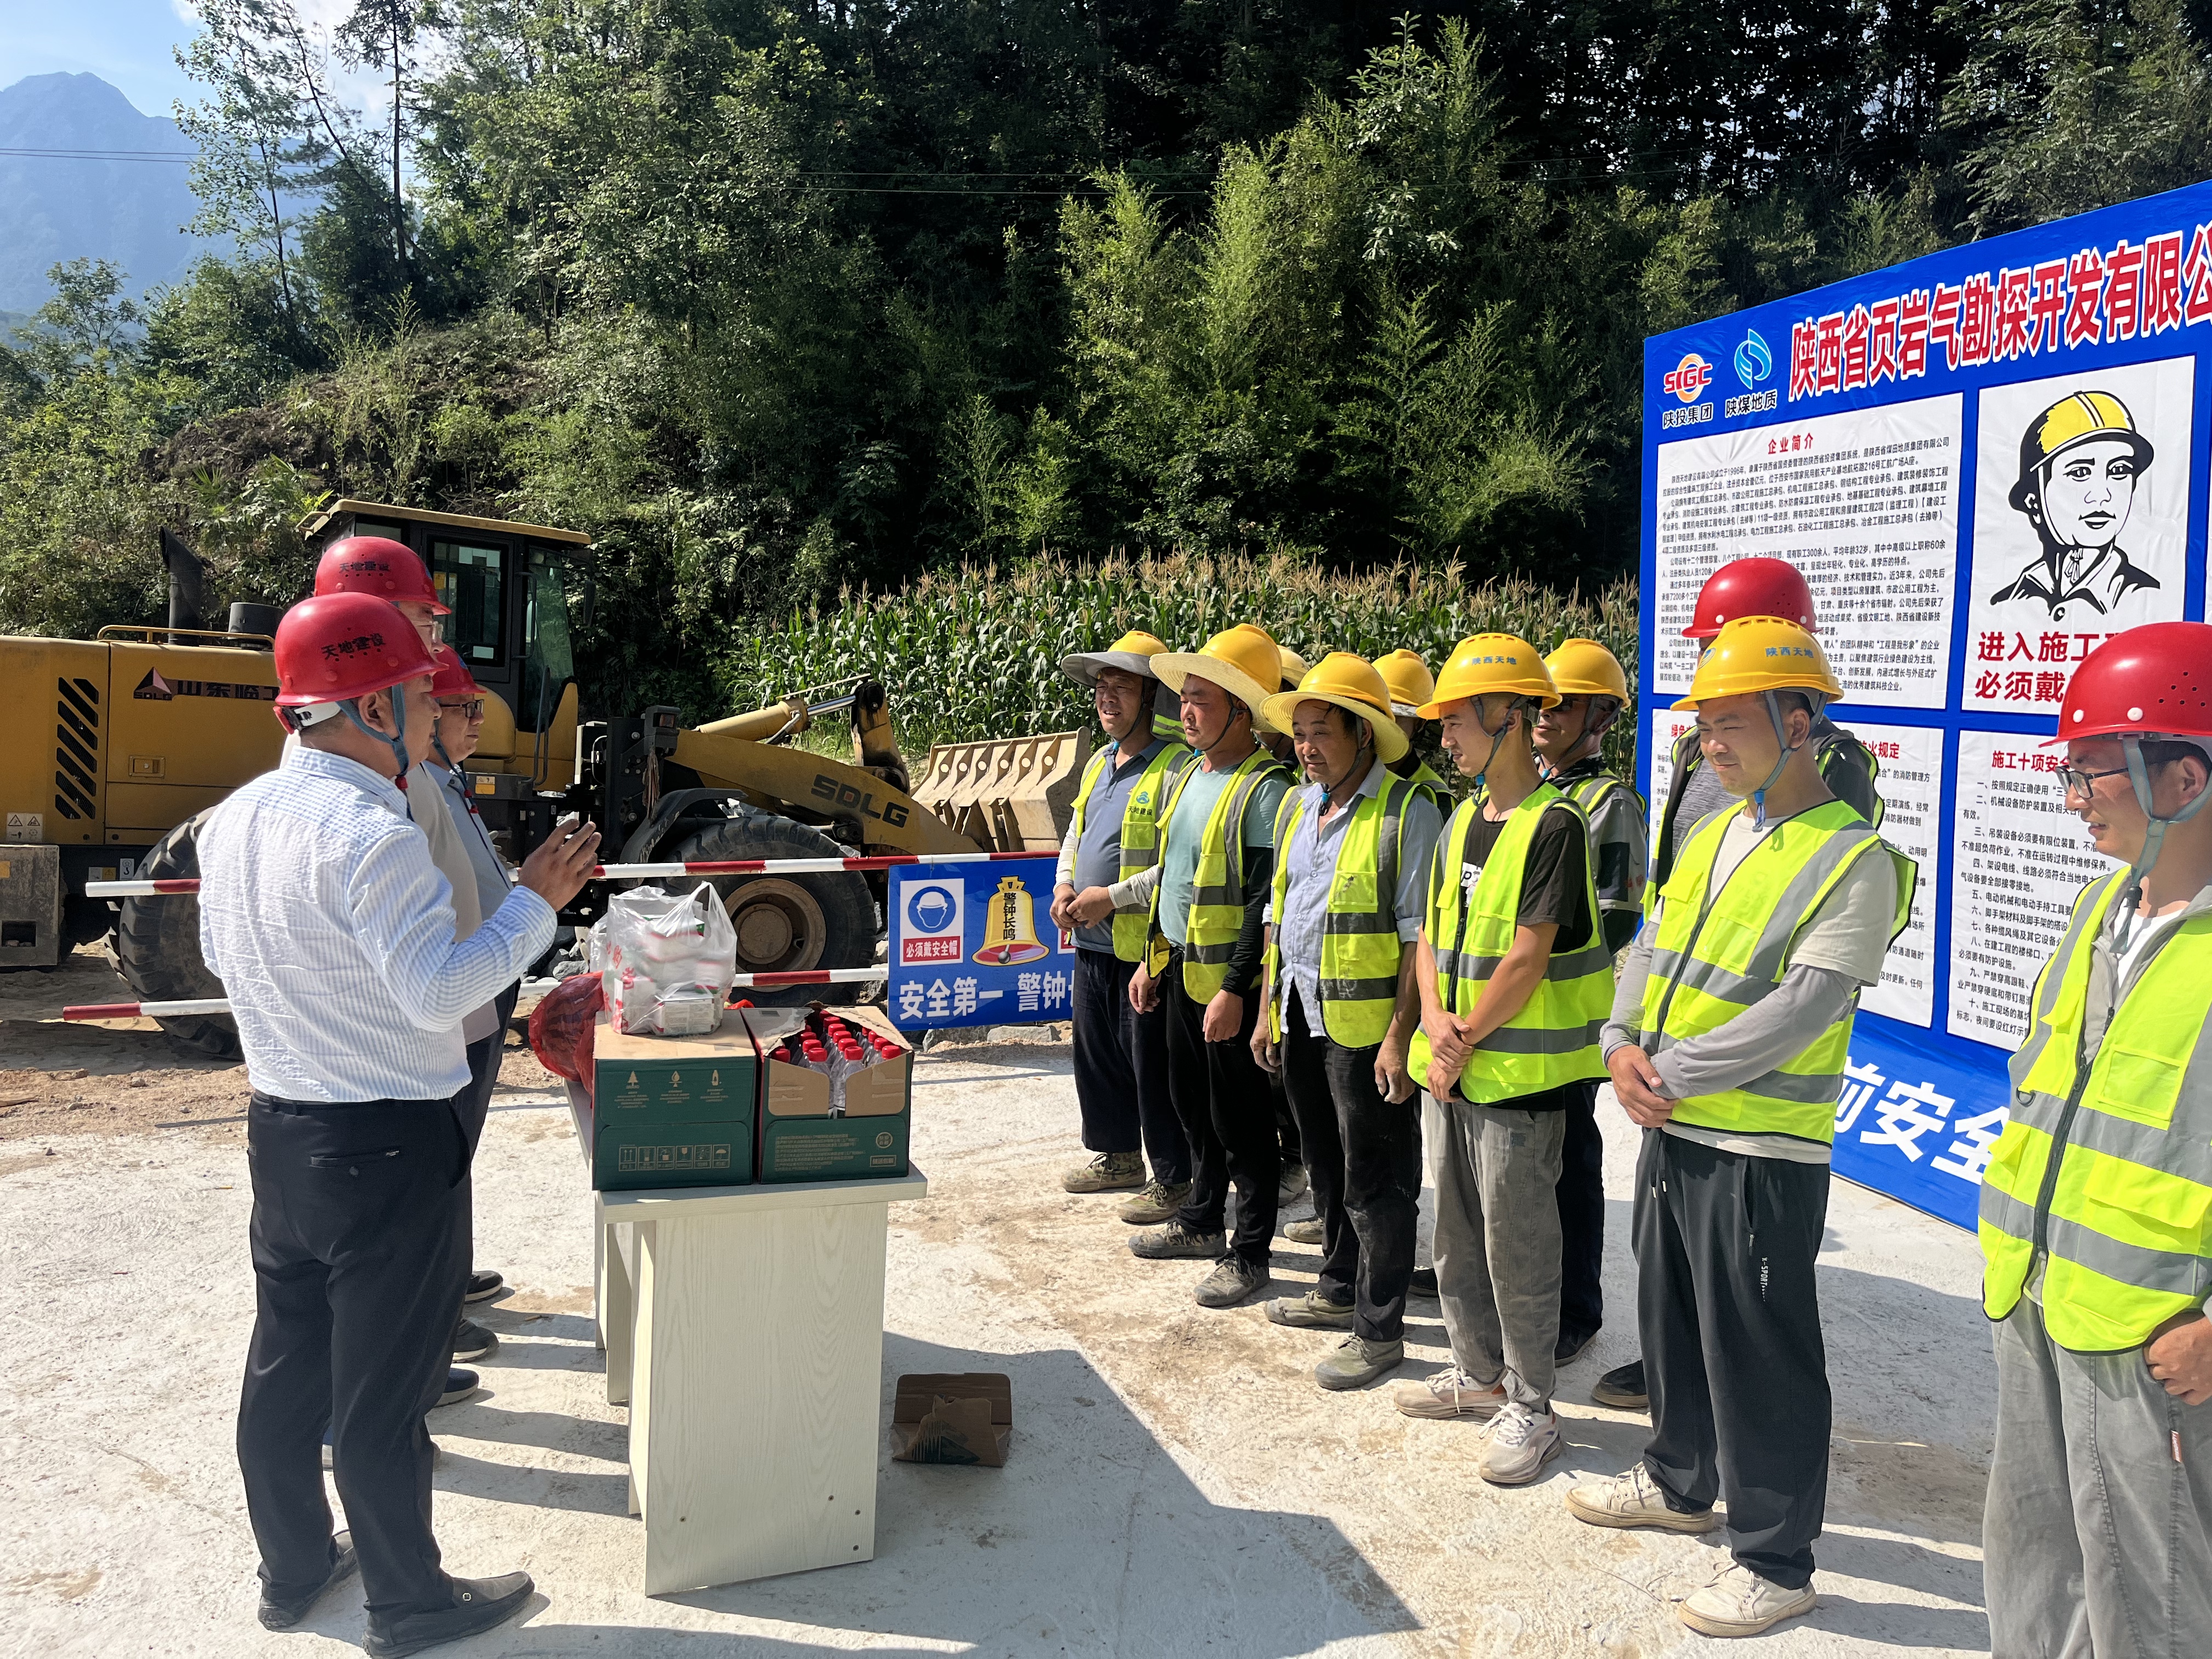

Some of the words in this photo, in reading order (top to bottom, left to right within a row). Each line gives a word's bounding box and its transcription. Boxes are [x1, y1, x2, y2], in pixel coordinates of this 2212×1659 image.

[1790, 222, 2212, 402] 陕西省页岩气勘探开发有限公
[1664, 364, 1713, 393] SIGC
[1725, 389, 1778, 418] 陕煤地质
[1663, 402, 1713, 430] 陕投集团
[1768, 433, 1813, 454] 企业简介
[1791, 556, 1910, 571] 丰富，呈现出年轻化、专业化、高学历的特点。
[1803, 568, 1945, 583] 备雄厚的经济、技术和管理实力。近3年来，公司先后
[1662, 592, 1700, 601] 承接了200多个工程
[1813, 597, 1944, 610] 、甘肃、重庆等十余个省市辐射。公司先后荣获了
[1813, 627, 1838, 635] 项荣誉。
[1765, 647, 1814, 658] 陕西天地
[1830, 666, 1937, 679] 平台、创新发展，内涵式增长与外延式扩
[1975, 670, 2073, 703] 必须戴
[1671, 724, 1691, 738] 绿色
[1861, 740, 1900, 759] 火规定
[1977, 780, 2067, 797] 一、按照规定正确使用“三
[811, 774, 909, 828] SDLG
[1883, 798, 1929, 812] 定期演练，经常
[1963, 809, 1980, 820] 有效。
[1003, 892, 1016, 940] 警钟长鸣
[906, 940, 958, 958] 必须戴安全帽
[1959, 949, 2016, 971] 必须要有防护设施。
[899, 977, 1003, 1021] 安全第一
[1760, 1257, 1768, 1286] X-SPORT
